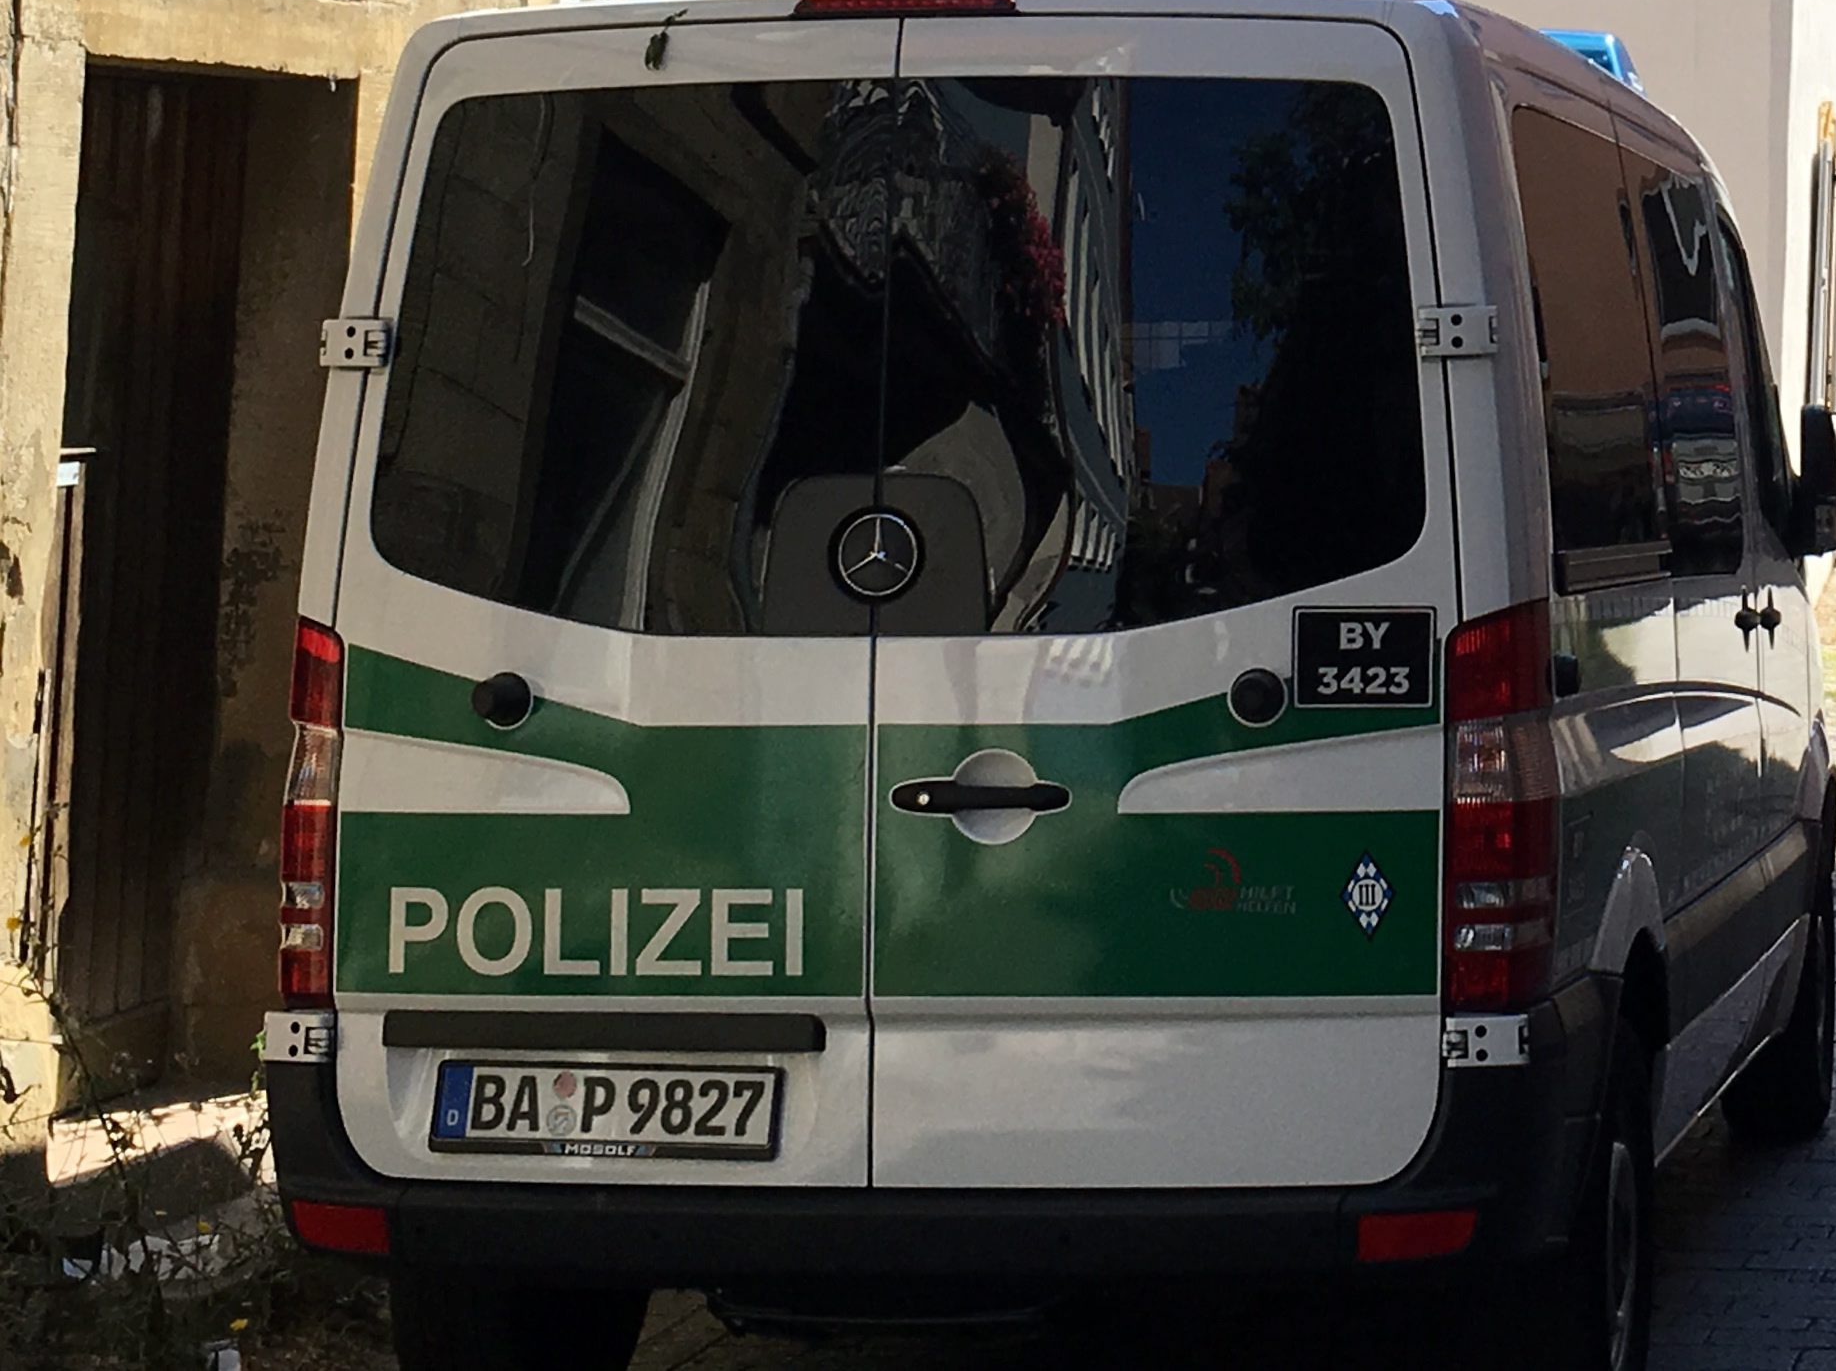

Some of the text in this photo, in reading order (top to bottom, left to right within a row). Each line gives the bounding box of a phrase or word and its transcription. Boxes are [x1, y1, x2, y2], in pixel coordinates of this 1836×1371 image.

[1339, 621, 1391, 651] BY
[1316, 665, 1411, 696] 3423
[387, 885, 804, 976] POLIZEI
[446, 1109, 460, 1127] D
[469, 1074, 768, 1137] BA P 9827
[564, 1142, 637, 1157] MOSOLF
